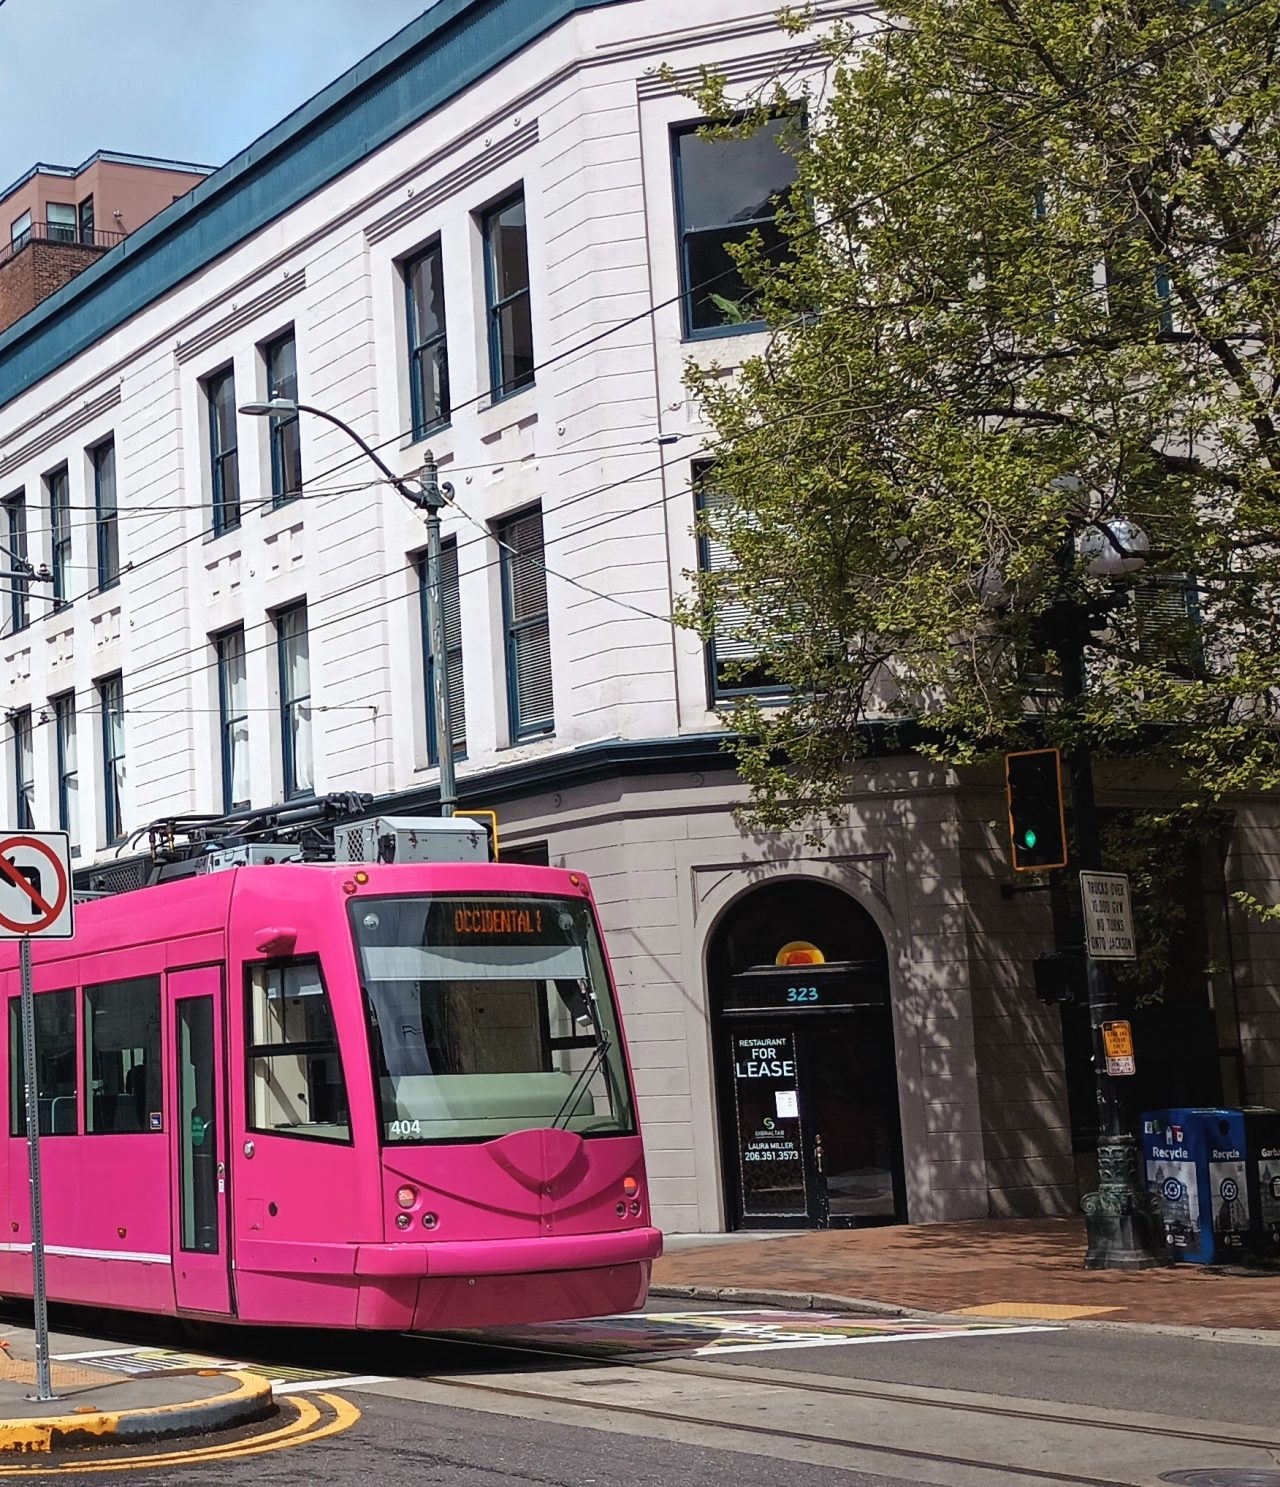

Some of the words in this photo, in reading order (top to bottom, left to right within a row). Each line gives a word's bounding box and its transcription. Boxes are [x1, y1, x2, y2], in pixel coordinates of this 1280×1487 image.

[1088, 881, 1108, 895] TRUCKS
[1110, 883, 1124, 896] OVER
[455, 909, 534, 933] OCCIDENTAL
[1096, 918, 1105, 931] NO
[1107, 918, 1124, 931] TURNS
[1091, 936, 1106, 950] ONTO
[1109, 937, 1132, 950] JACKSON
[786, 987, 819, 1002] 323
[739, 1038, 786, 1047] RESTAURANT
[752, 1047, 777, 1060] FOR
[736, 1060, 795, 1078] LEASE
[390, 1119, 422, 1135] 404
[748, 1142, 770, 1150] LAURA
[770, 1142, 794, 1150] MILLER
[1152, 1146, 1189, 1160] Recycle
[744, 1150, 799, 1161] 206.351.3573
[1212, 1148, 1240, 1160] Recycle
